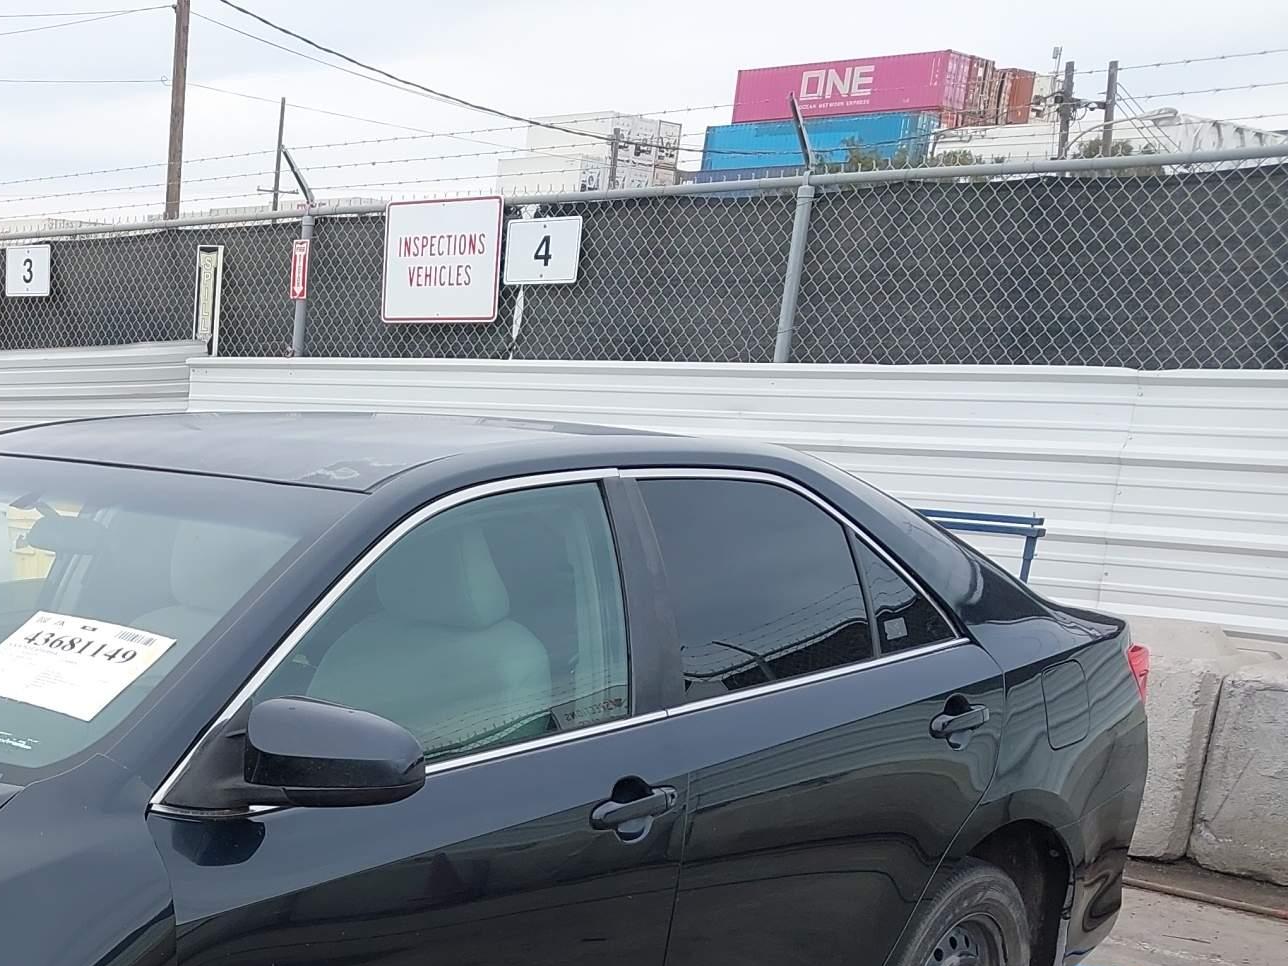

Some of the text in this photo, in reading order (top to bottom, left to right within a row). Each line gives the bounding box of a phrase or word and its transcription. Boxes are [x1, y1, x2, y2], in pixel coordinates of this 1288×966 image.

[799, 65, 875, 100] ONE
[398, 233, 486, 258] INSPECTIONS
[533, 234, 553, 267] 4
[22, 258, 34, 284] 3
[408, 264, 472, 288] VEHICLES
[23, 630, 138, 664] 43681149
